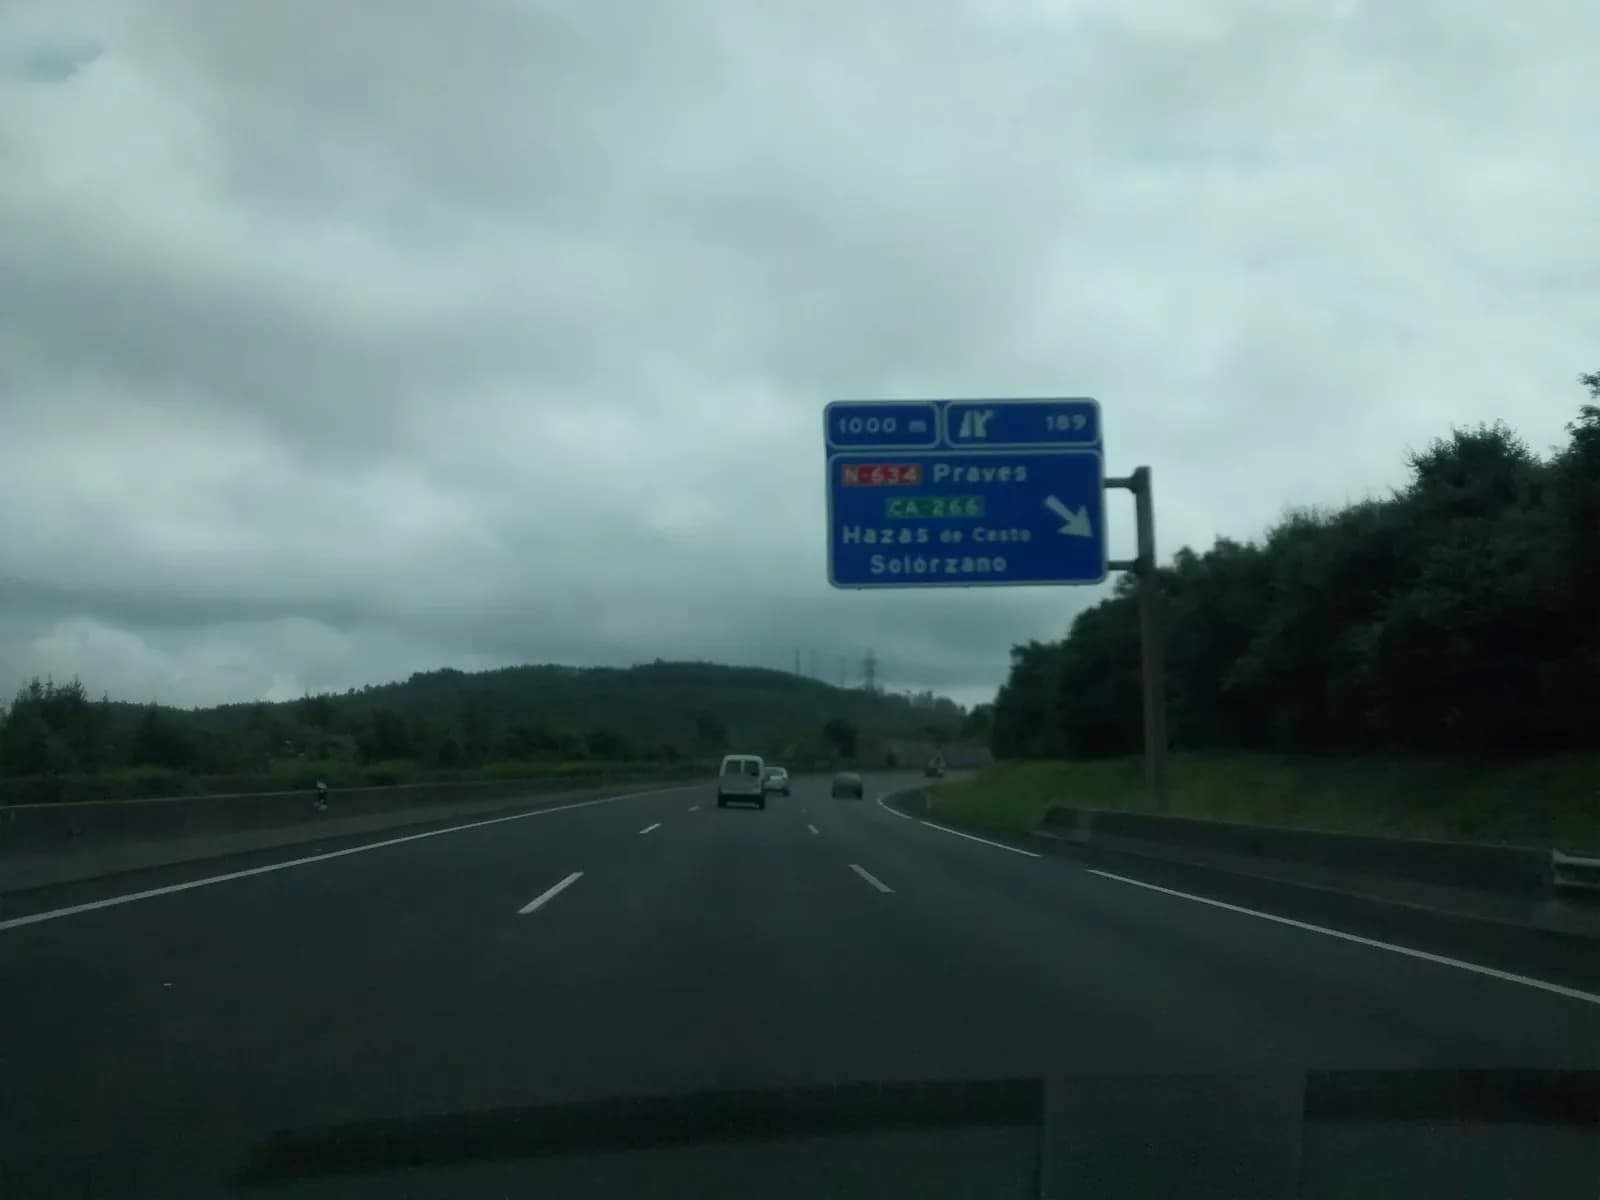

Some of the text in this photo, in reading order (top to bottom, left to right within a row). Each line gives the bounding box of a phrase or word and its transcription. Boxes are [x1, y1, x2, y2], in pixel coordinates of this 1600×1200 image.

[839, 417, 927, 434] 1000 m
[1046, 414, 1088, 431] 189
[843, 463, 1028, 485] N-634 Praves
[842, 525, 929, 545] Hazas
[939, 528, 963, 543] de
[869, 553, 1008, 575] Solórzano
